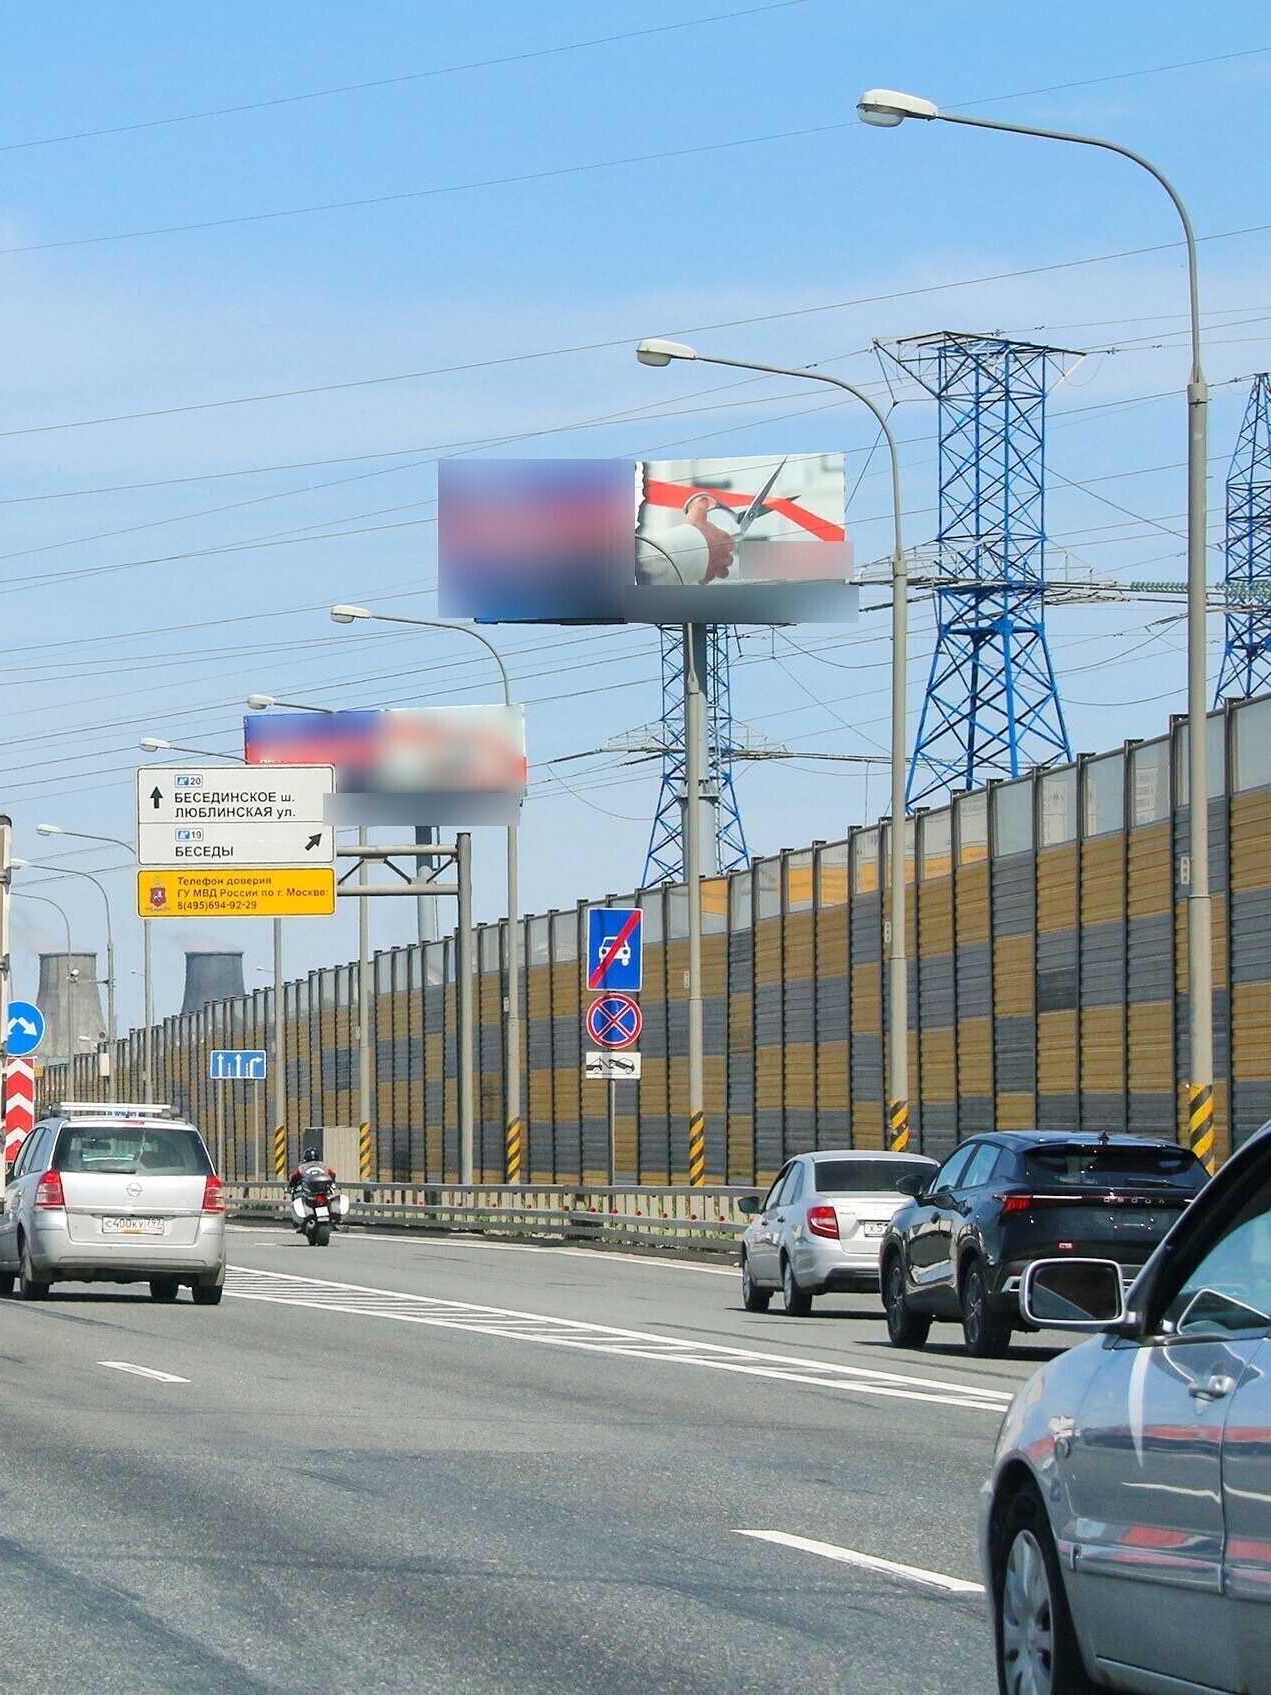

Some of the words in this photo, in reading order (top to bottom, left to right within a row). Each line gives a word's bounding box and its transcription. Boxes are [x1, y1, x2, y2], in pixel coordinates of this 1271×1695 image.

[190, 777, 201, 786] 20
[174, 792, 276, 804] БЕСЕДИНСКОЕ
[281, 794, 295, 802] ш.
[175, 807, 272, 818] ЛЮБЛИНСКАЯ
[276, 809, 296, 819] ул.
[191, 830, 202, 839] 19
[175, 846, 234, 858] БЕСЕДЫ
[177, 877, 223, 886] Телефон
[226, 877, 272, 886] доверия
[177, 889, 190, 898] ГУ
[193, 889, 217, 898] МВД
[220, 888, 258, 898] России
[261, 889, 274, 897] по
[277, 889, 284, 897] г.
[286, 887, 329, 897] Москве:
[177, 900, 257, 911] 8(495)694-92-29
